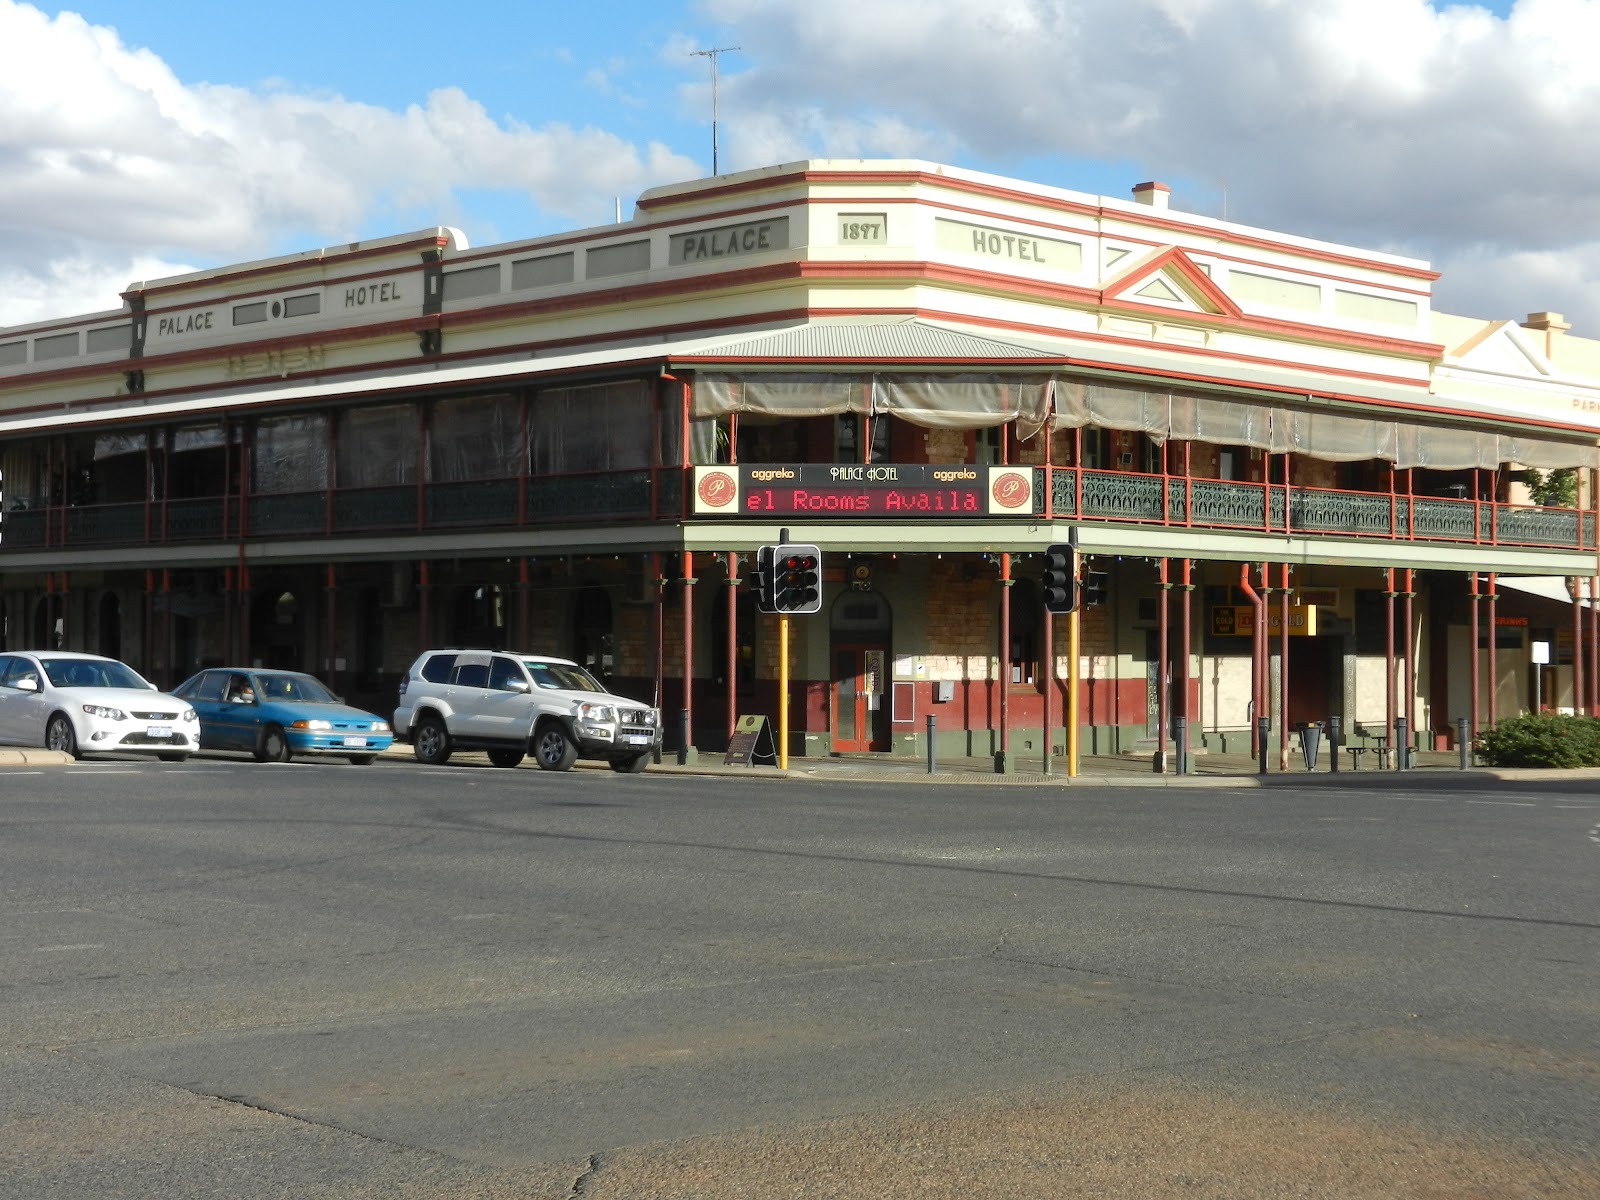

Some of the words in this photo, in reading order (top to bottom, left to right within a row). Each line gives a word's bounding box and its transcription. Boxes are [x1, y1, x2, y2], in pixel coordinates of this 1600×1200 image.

[842, 222, 883, 241] 1897
[683, 226, 771, 261] PALACE
[972, 229, 1046, 263] HOTEL
[158, 310, 213, 336] PALACE
[344, 281, 401, 308] HOTEL
[751, 467, 795, 481] aggreko
[829, 467, 864, 482] PALACE
[866, 467, 899, 482] HOTEL
[933, 467, 977, 482] aggreko
[747, 490, 775, 510] el
[793, 490, 870, 510] Rooms
[885, 490, 978, 511] Availa
[1271, 614, 1304, 626] GLD
